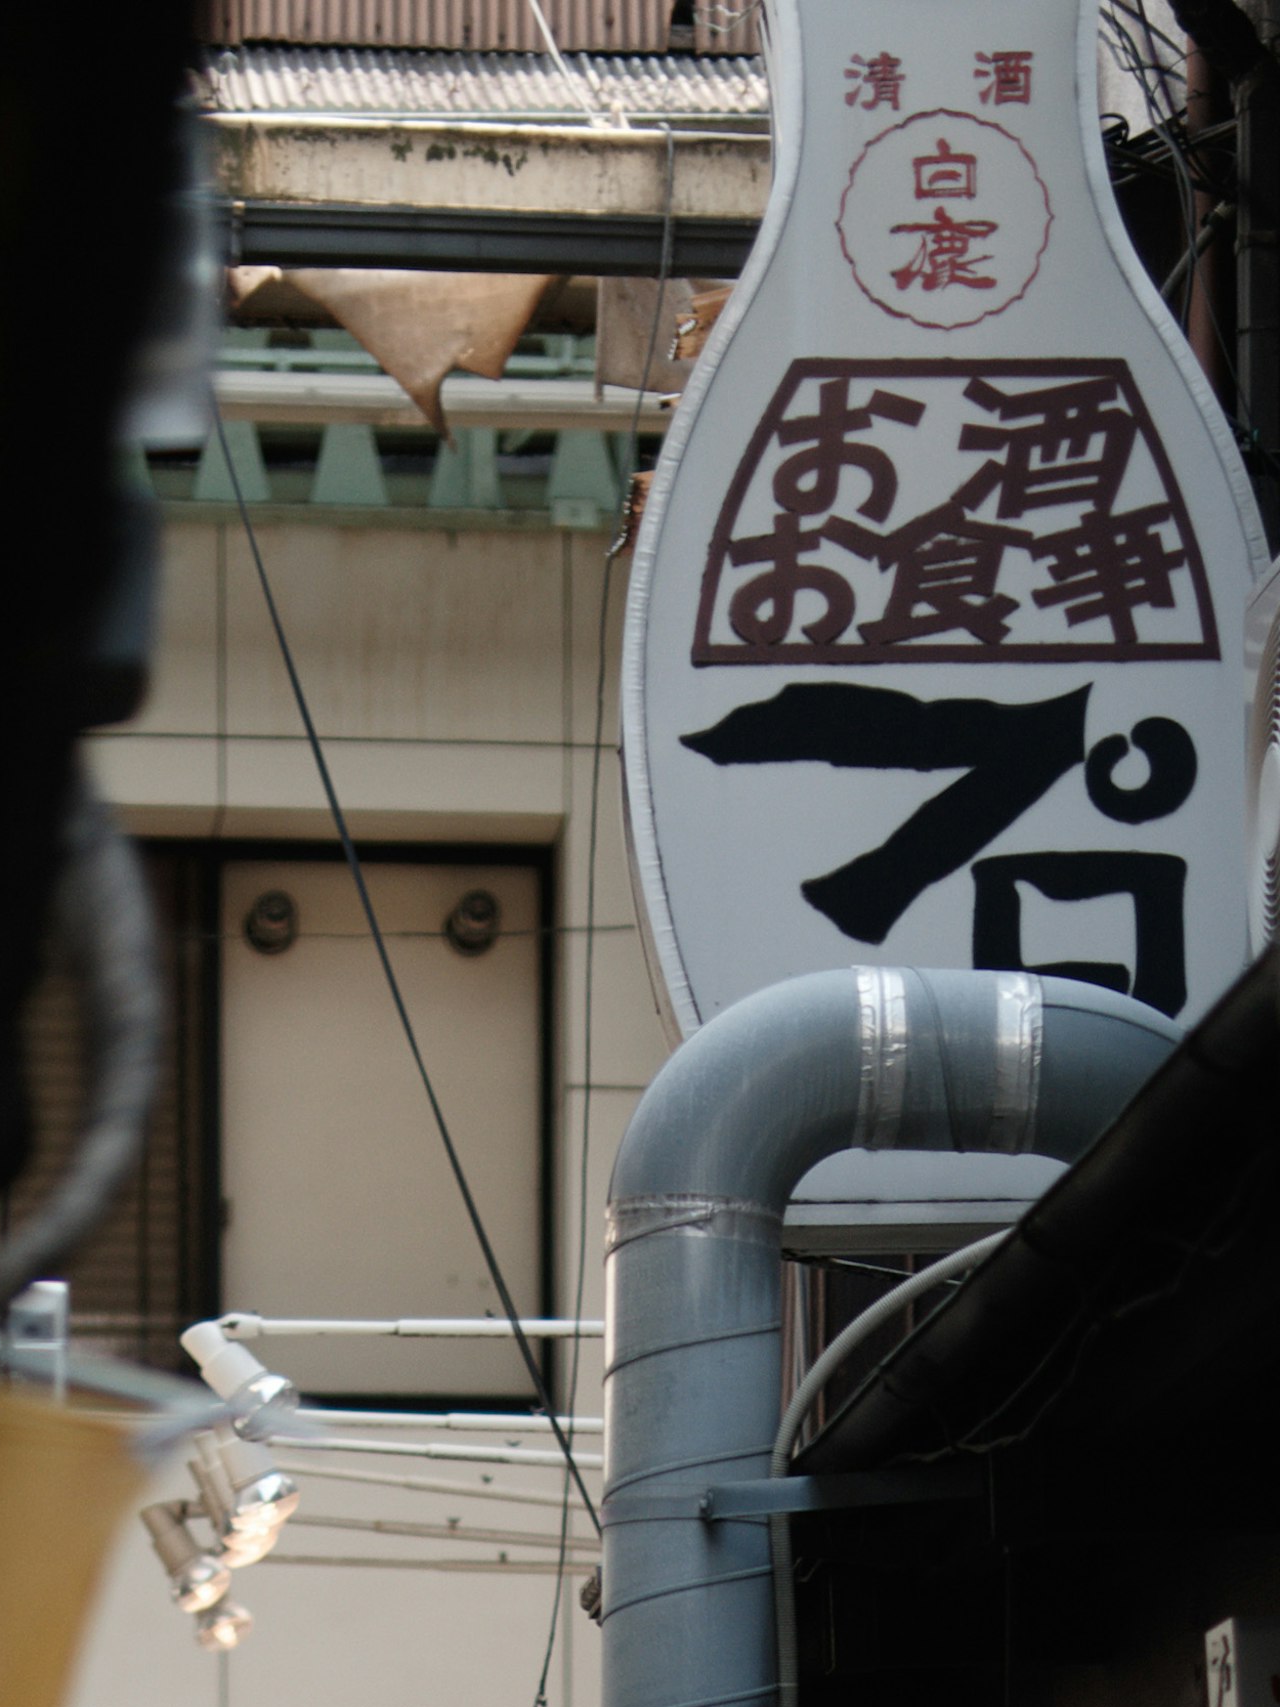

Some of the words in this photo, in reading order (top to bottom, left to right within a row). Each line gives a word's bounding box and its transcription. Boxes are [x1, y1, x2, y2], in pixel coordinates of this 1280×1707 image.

[843, 50, 1033, 110] 清酒
[770, 375, 1142, 522] お酒
[725, 508, 1187, 646] お食事
[678, 682, 1200, 1020] プロ
